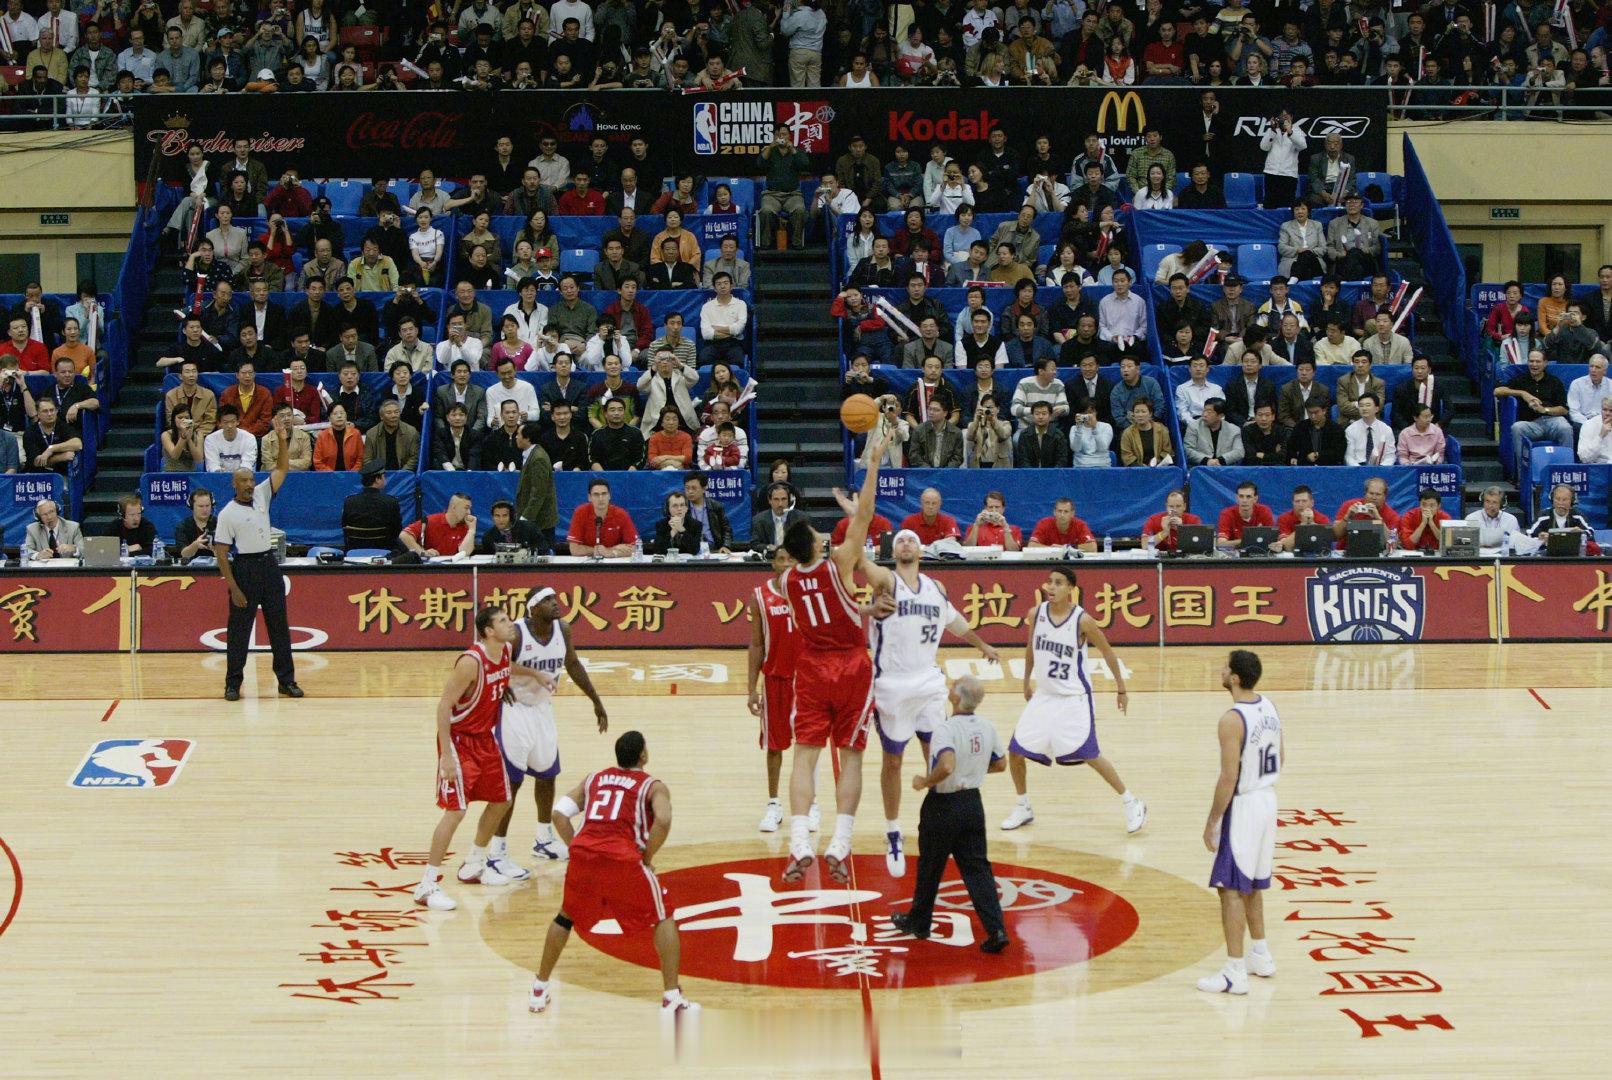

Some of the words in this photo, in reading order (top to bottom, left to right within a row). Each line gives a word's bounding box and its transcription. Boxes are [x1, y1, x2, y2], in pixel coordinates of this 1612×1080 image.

[720, 102, 774, 122] CHINA
[597, 123, 618, 131] HONG
[620, 123, 641, 131] KONG
[720, 124, 774, 144] GAMES
[888, 110, 1000, 141] Kodak
[720, 146, 768, 155] 200
[799, 577, 818, 592] YAO
[1328, 567, 1402, 582] SACRAMENTO
[801, 591, 831, 627] 11
[897, 599, 940, 621] Kings
[1313, 583, 1417, 638] KINGS
[920, 624, 938, 644] 52
[1034, 633, 1075, 660] Kings
[1047, 660, 1071, 680] 23
[970, 736, 980, 754] 15
[1258, 742, 1277, 778] 16
[81, 776, 140, 786] NBA
[597, 774, 637, 790] JACKSON
[588, 789, 625, 820] 21
